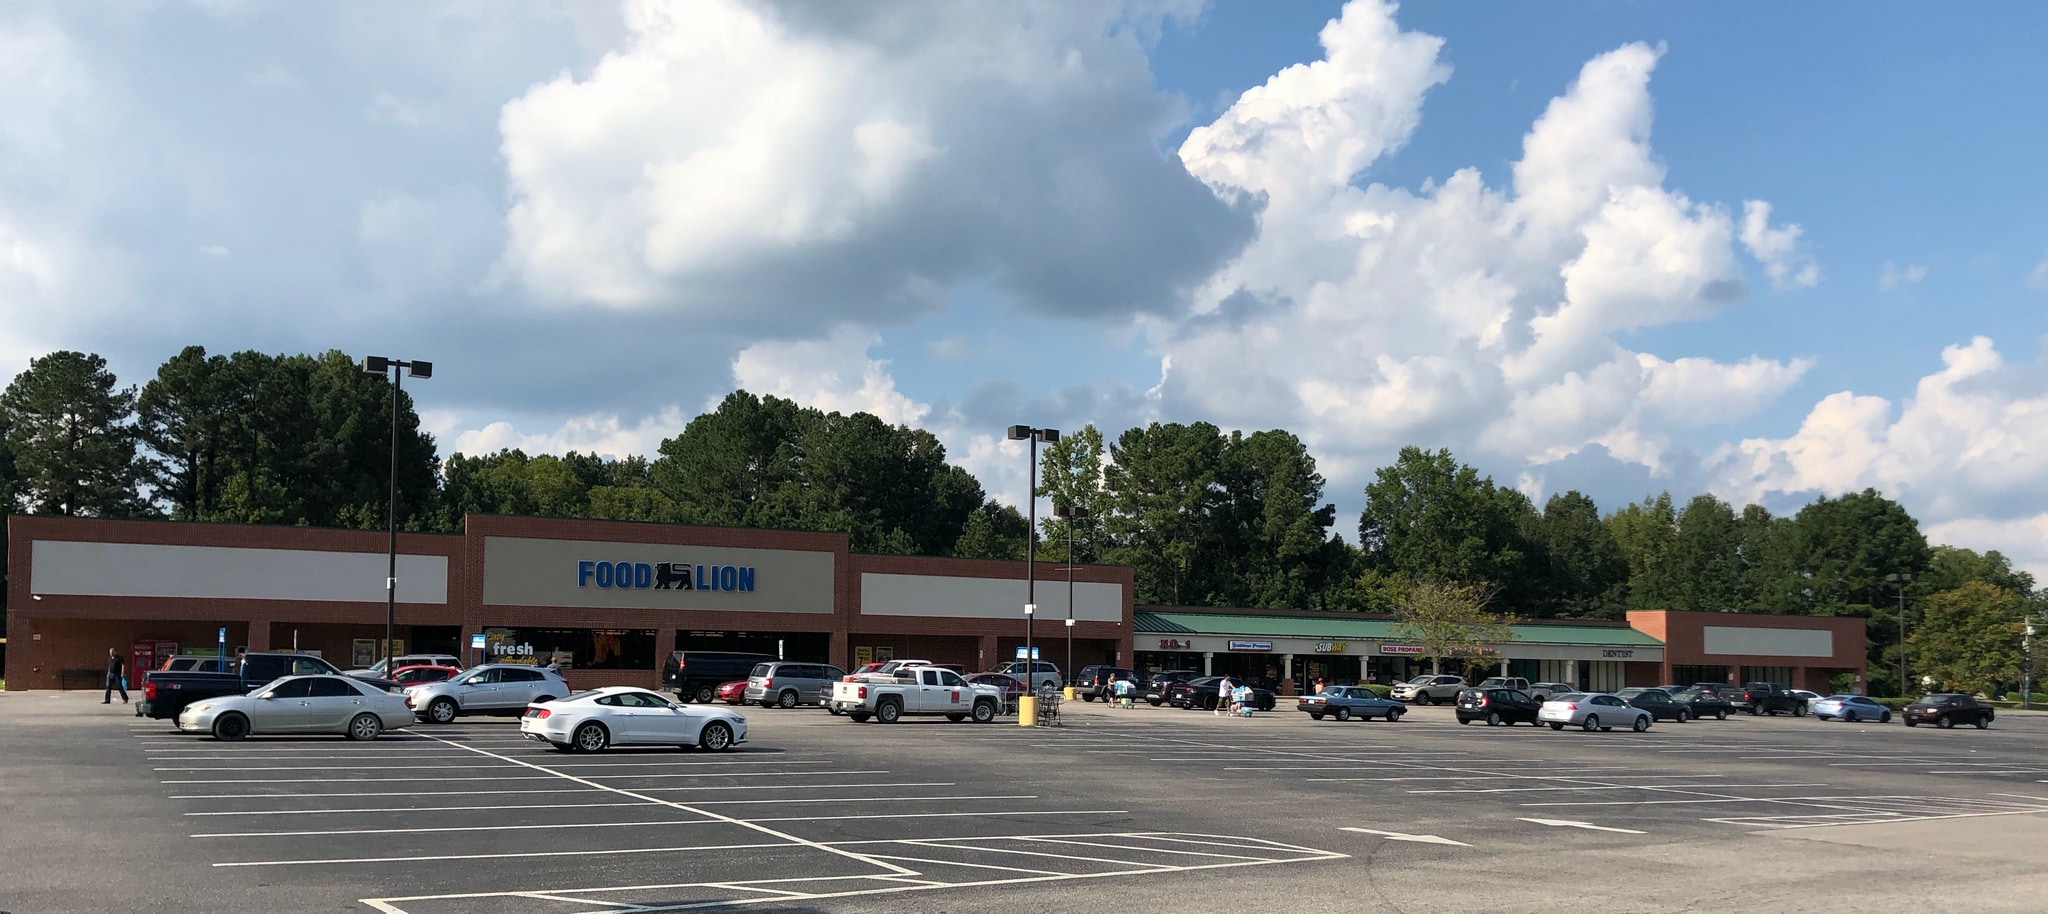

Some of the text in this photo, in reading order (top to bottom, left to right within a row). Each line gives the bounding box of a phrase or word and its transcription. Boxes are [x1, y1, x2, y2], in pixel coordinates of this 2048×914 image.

[578, 560, 755, 592] FOOD LION
[493, 642, 533, 655] fresh
[1315, 641, 1348, 652] SUBWAY
[1602, 650, 1634, 658] DENTIST
